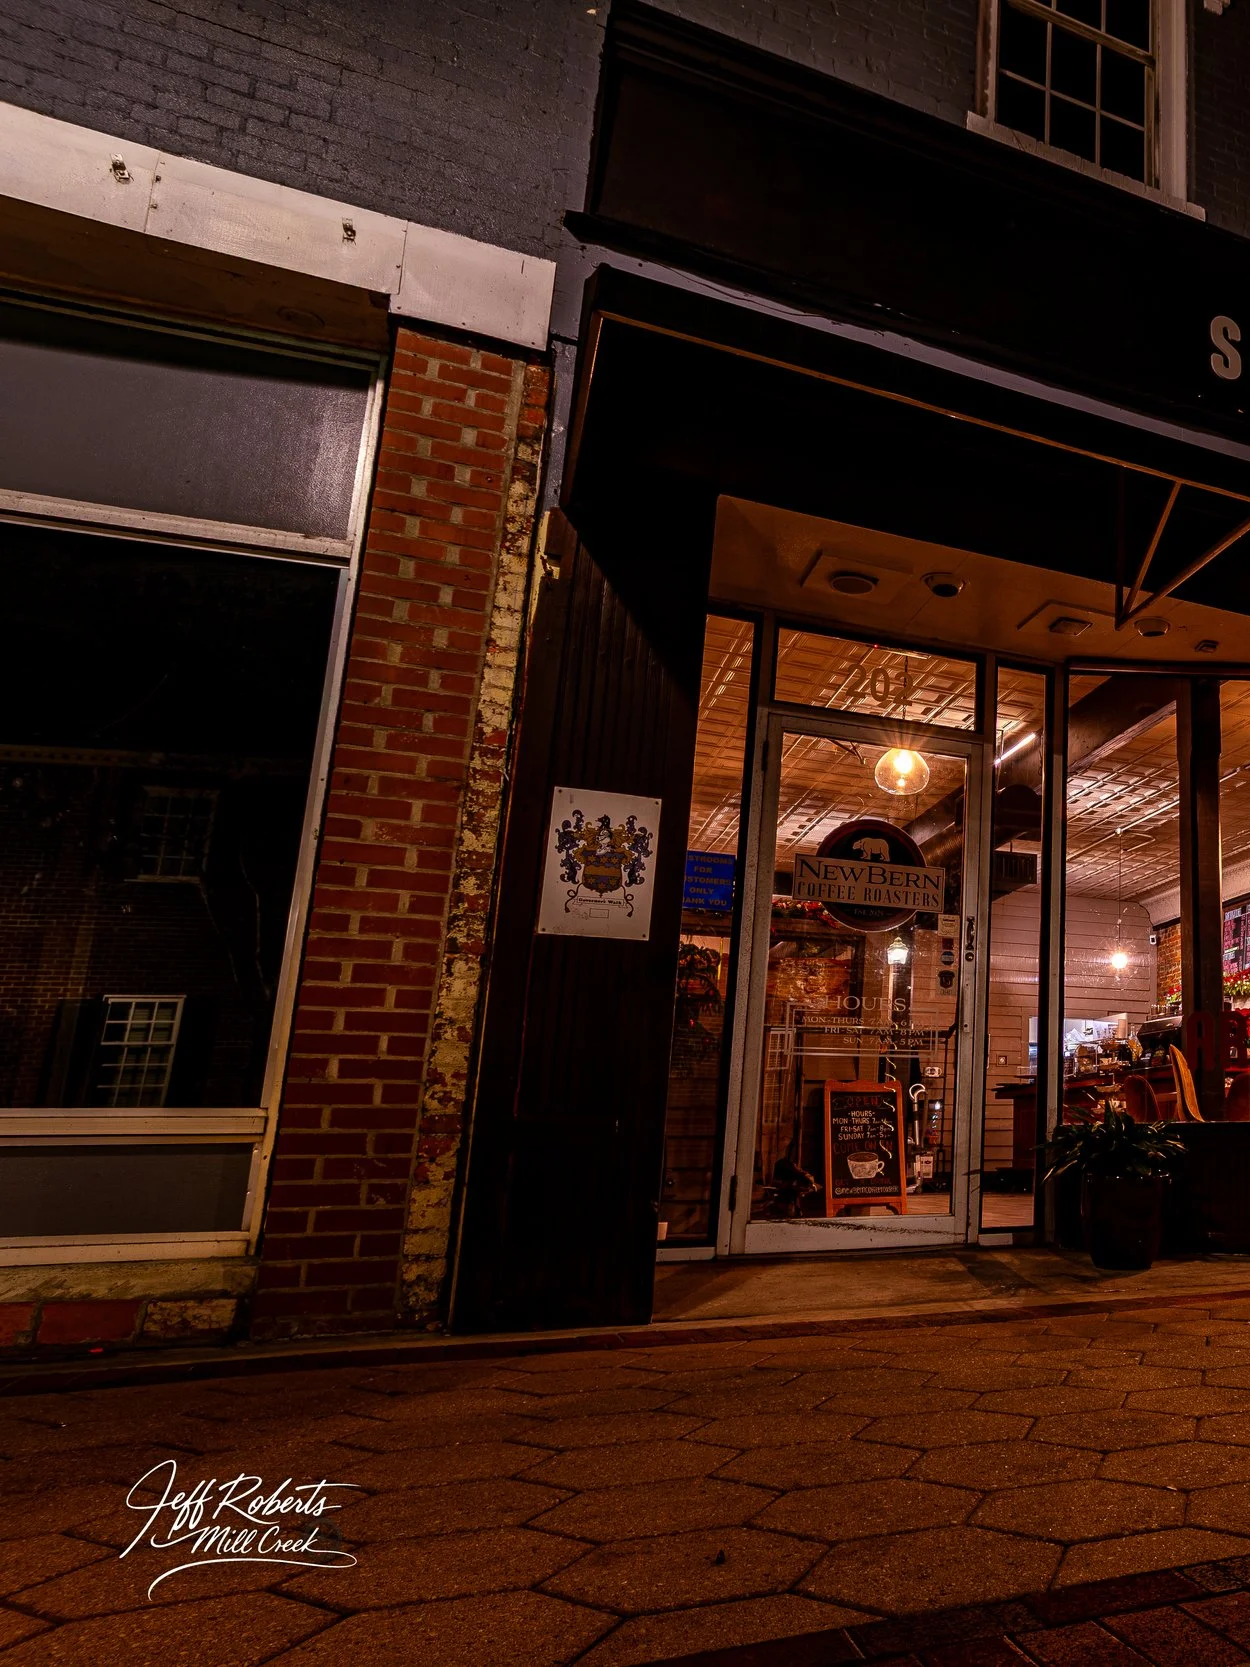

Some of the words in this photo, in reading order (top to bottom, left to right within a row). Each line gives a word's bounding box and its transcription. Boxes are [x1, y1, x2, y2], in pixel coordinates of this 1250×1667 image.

[845, 664, 914, 707] 202
[687, 855, 733, 865] STROOMS
[694, 866, 713, 874] FOR
[687, 876, 731, 885] STOMERS
[689, 886, 714, 895] ONLY
[797, 881, 856, 900] COFFEE
[863, 887, 940, 908] ROASTERS
[684, 896, 705, 905] ANK
[825, 995, 907, 1012] HOURS
[843, 1037, 864, 1045] SUN
[838, 1132, 865, 1141] SUNDAY
